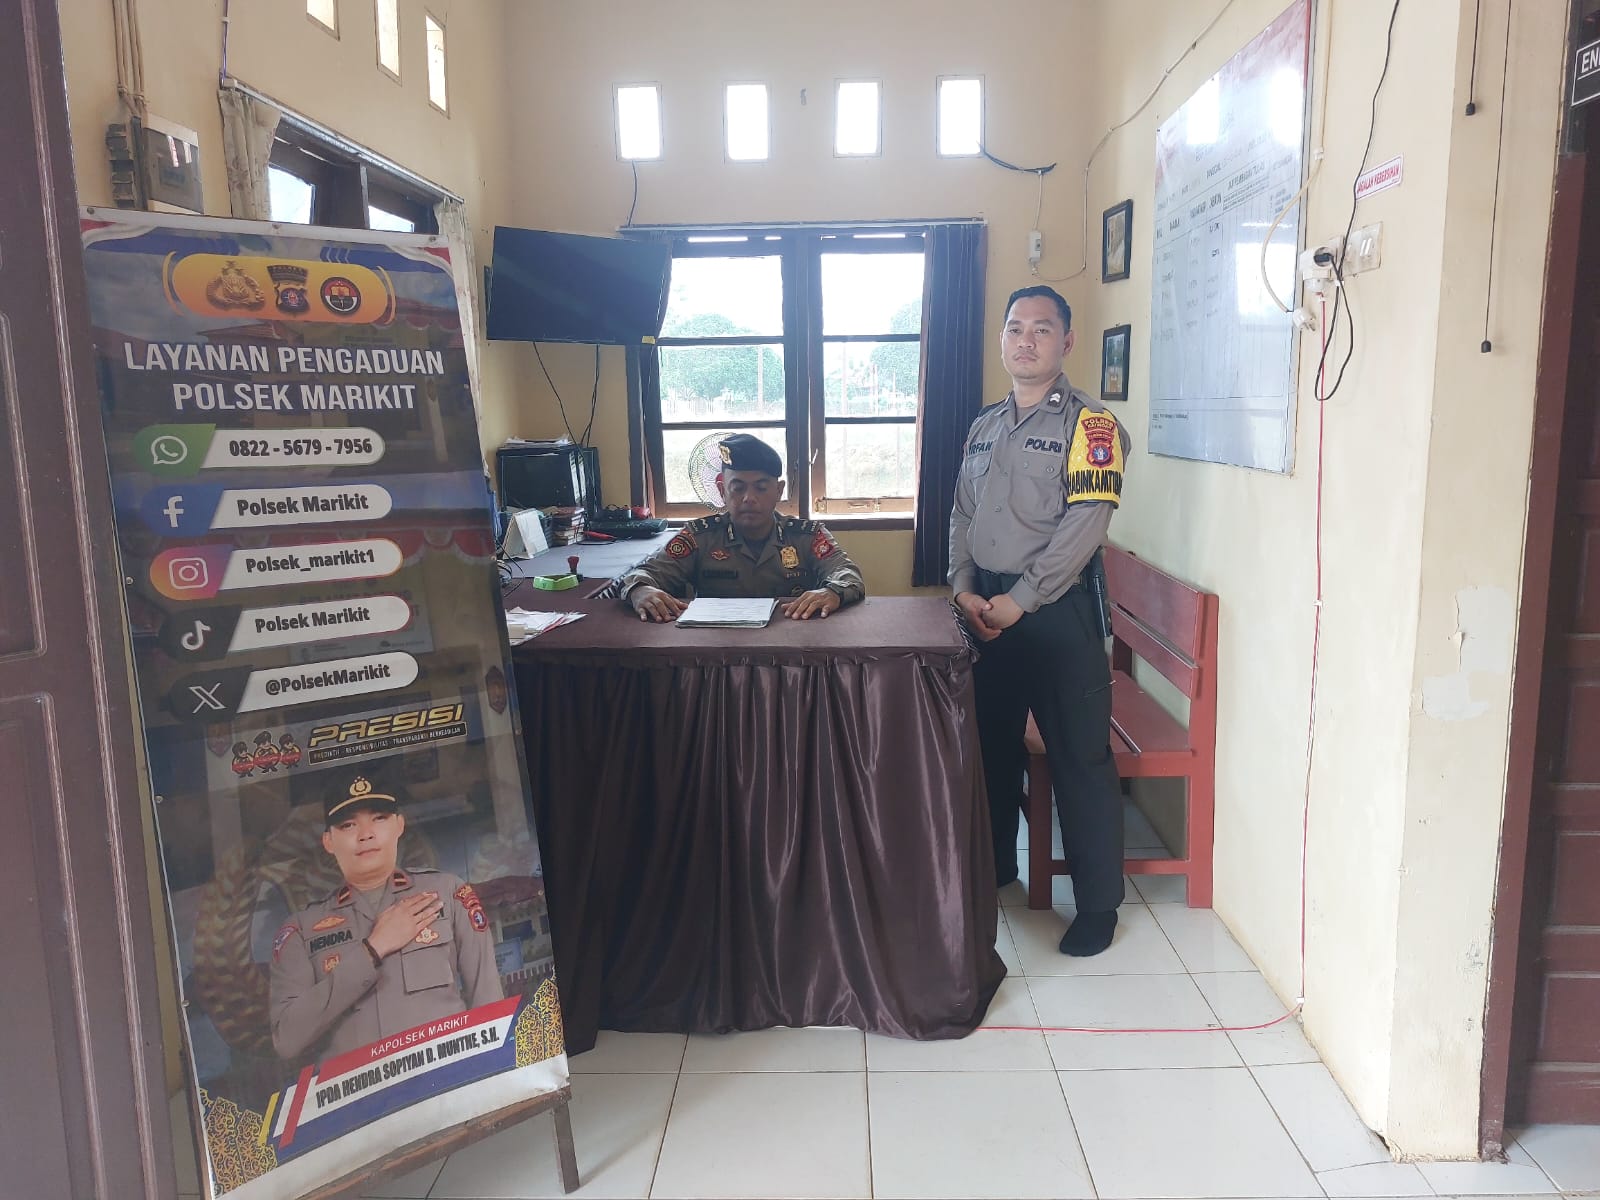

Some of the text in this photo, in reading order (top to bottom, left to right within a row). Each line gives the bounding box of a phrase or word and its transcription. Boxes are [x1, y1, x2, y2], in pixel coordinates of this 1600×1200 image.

[124, 342, 445, 375] LAYANAN PENGADUAN
[173, 383, 416, 410] POLSEK MARIKIT
[229, 439, 271, 457] 0822
[283, 438, 323, 456] 5679
[334, 438, 373, 456] 7956
[1024, 437, 1063, 454] POLRI
[237, 493, 369, 517] Polsek Marikit
[245, 548, 375, 574] Polsek_marikit1
[255, 606, 370, 633] Polsek Marikit
[265, 663, 391, 696] @PolsekMarikit
[308, 703, 464, 747] PRESISI
[309, 929, 353, 954] HENDRA
[370, 1014, 469, 1057] KAPOLSEK MARIKIT
[316, 1026, 499, 1109] IPDA HENDRA SOPIYAN D. MUNTHE, S.H.
